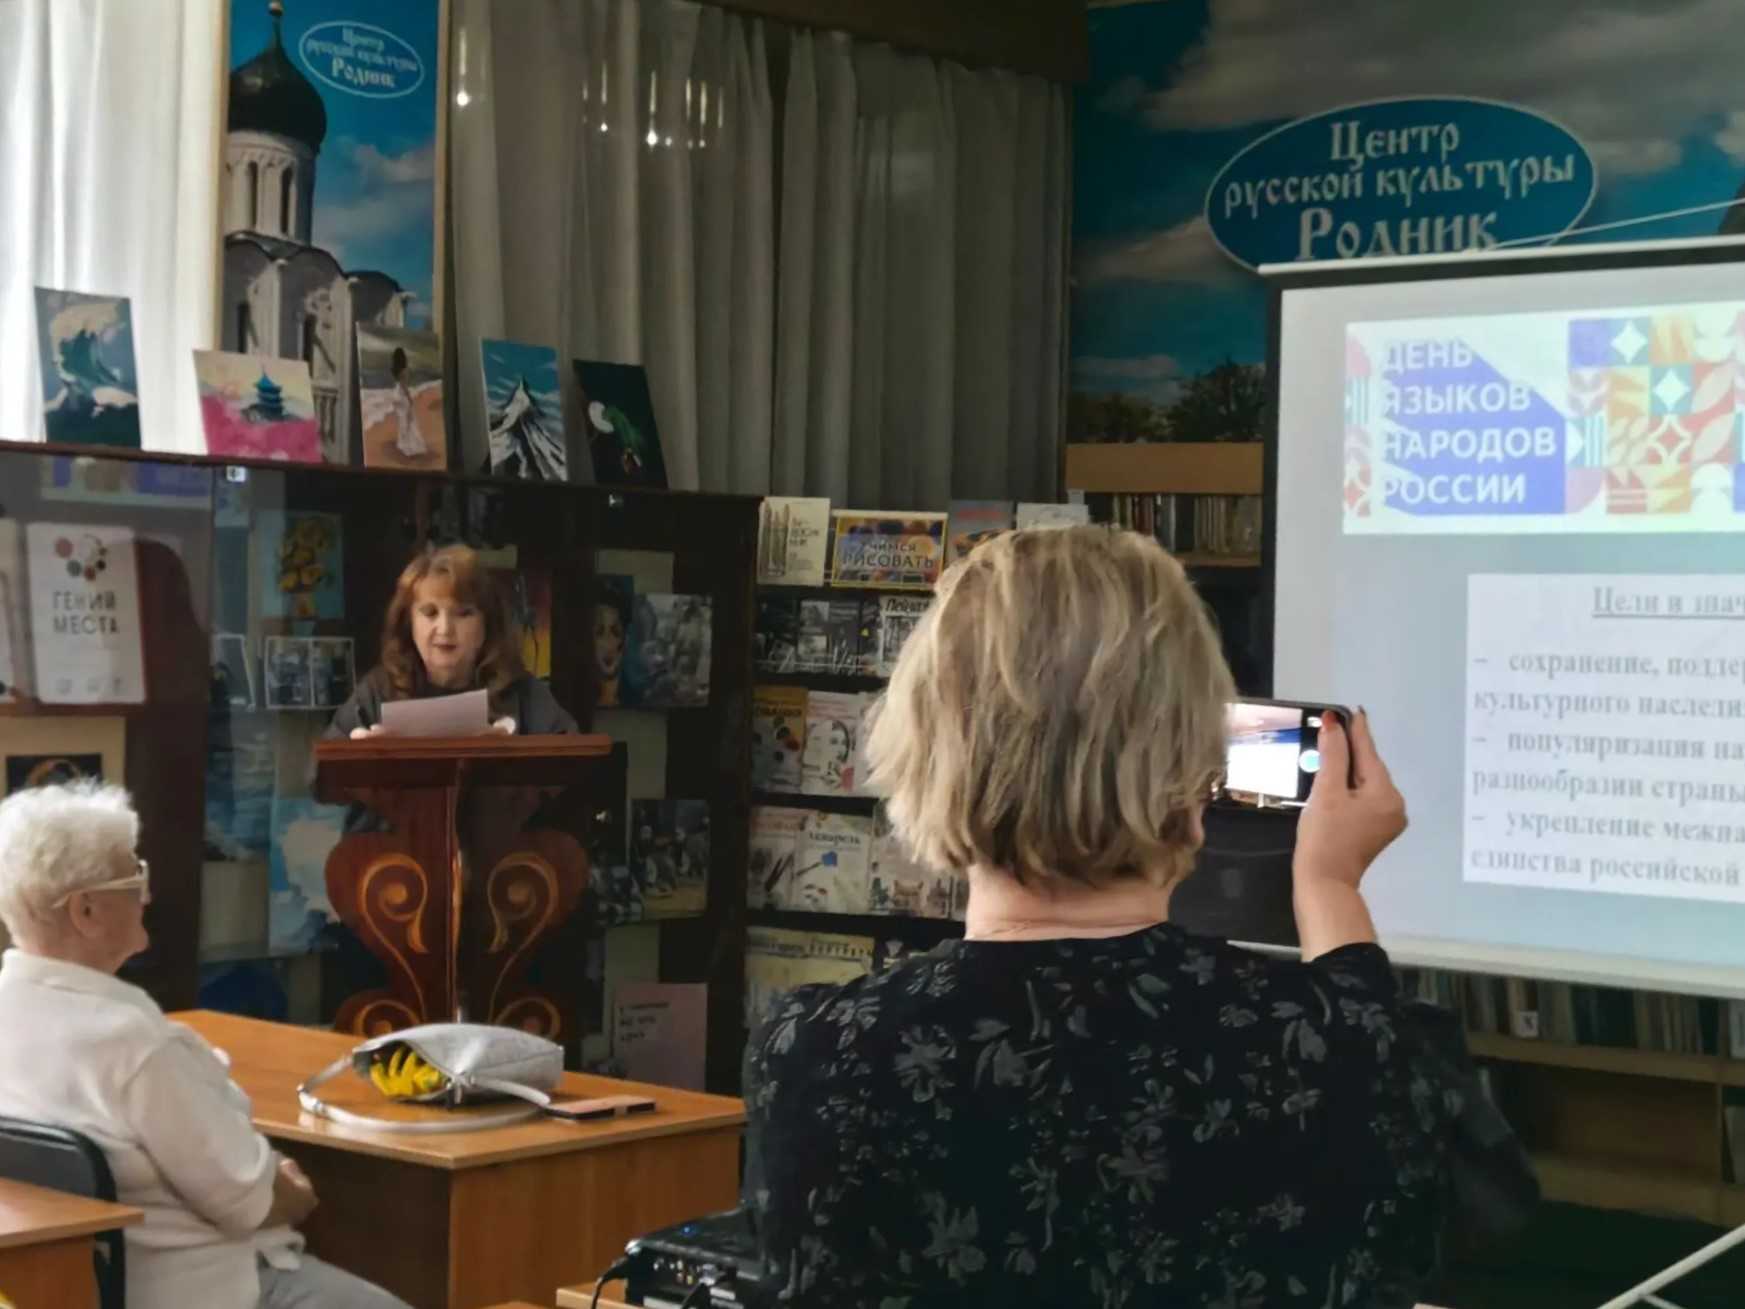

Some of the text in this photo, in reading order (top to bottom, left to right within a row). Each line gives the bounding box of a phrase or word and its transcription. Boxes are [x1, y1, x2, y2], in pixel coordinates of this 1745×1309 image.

[1329, 120, 1460, 171] Центр
[1224, 154, 1576, 219] русской культуры
[1295, 206, 1498, 261] Родник
[1384, 382, 1532, 415] ЯЗЫКОВ
[1384, 427, 1557, 463] НАРОДОВ
[1384, 473, 1526, 504] РОССИИ
[842, 552, 935, 570] РИСОВАТЬ
[53, 590, 117, 612] ГЕНИЙ
[1593, 586, 1660, 616] Цели
[1668, 595, 1684, 614] и
[53, 616, 120, 635] МЕСТА
[1508, 654, 1660, 680] сохранение,
[1474, 691, 1745, 719] культурного наследи
[1507, 731, 1705, 762] популяризация
[1472, 769, 1644, 802] разнообразии
[1505, 811, 1660, 840] укрепление
[1470, 850, 1741, 886] единства российской
